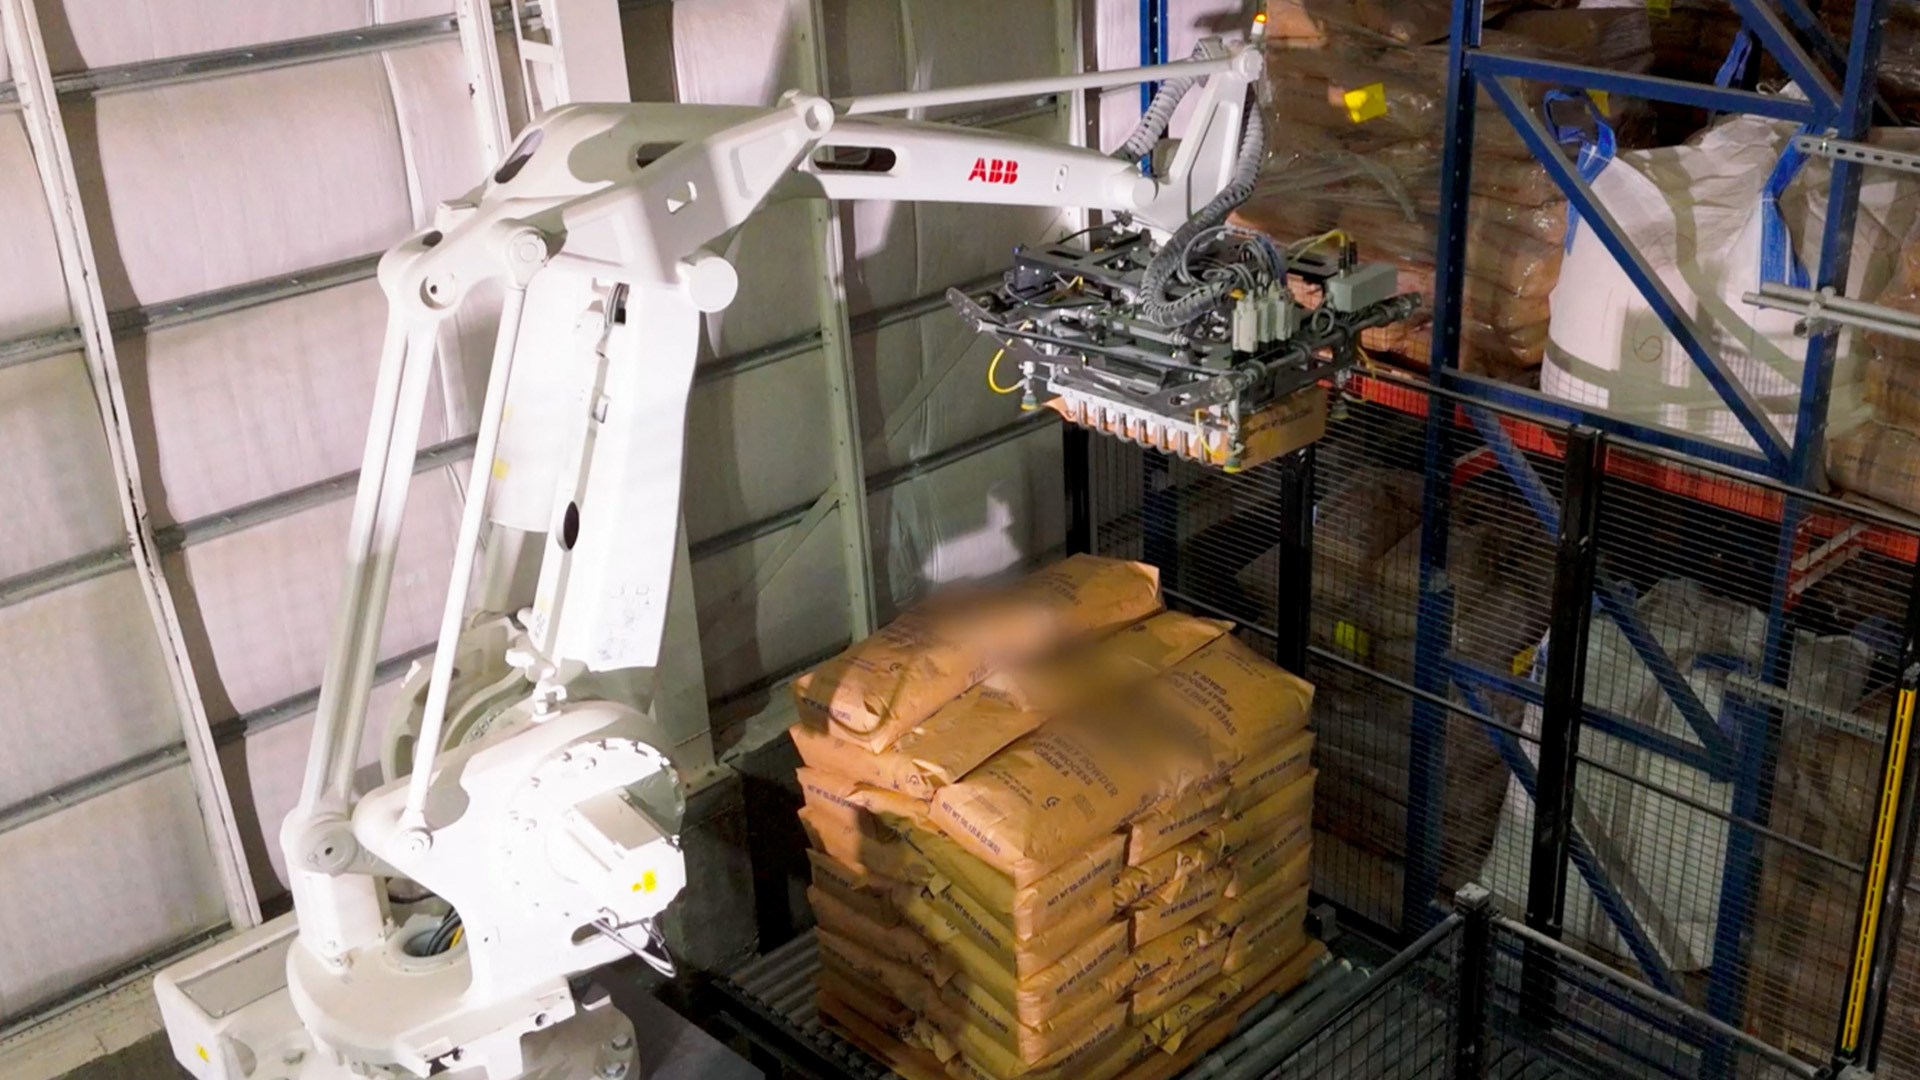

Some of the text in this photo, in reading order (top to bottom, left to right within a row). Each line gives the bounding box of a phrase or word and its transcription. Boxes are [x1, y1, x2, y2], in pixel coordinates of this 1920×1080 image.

[968, 157, 1018, 184] ABB
[1033, 746, 1063, 770] GRADE
[1054, 749, 1095, 787] PROCESS
[1079, 755, 1120, 798] POWDER
[940, 802, 951, 813] NET
[949, 810, 960, 820] WT
